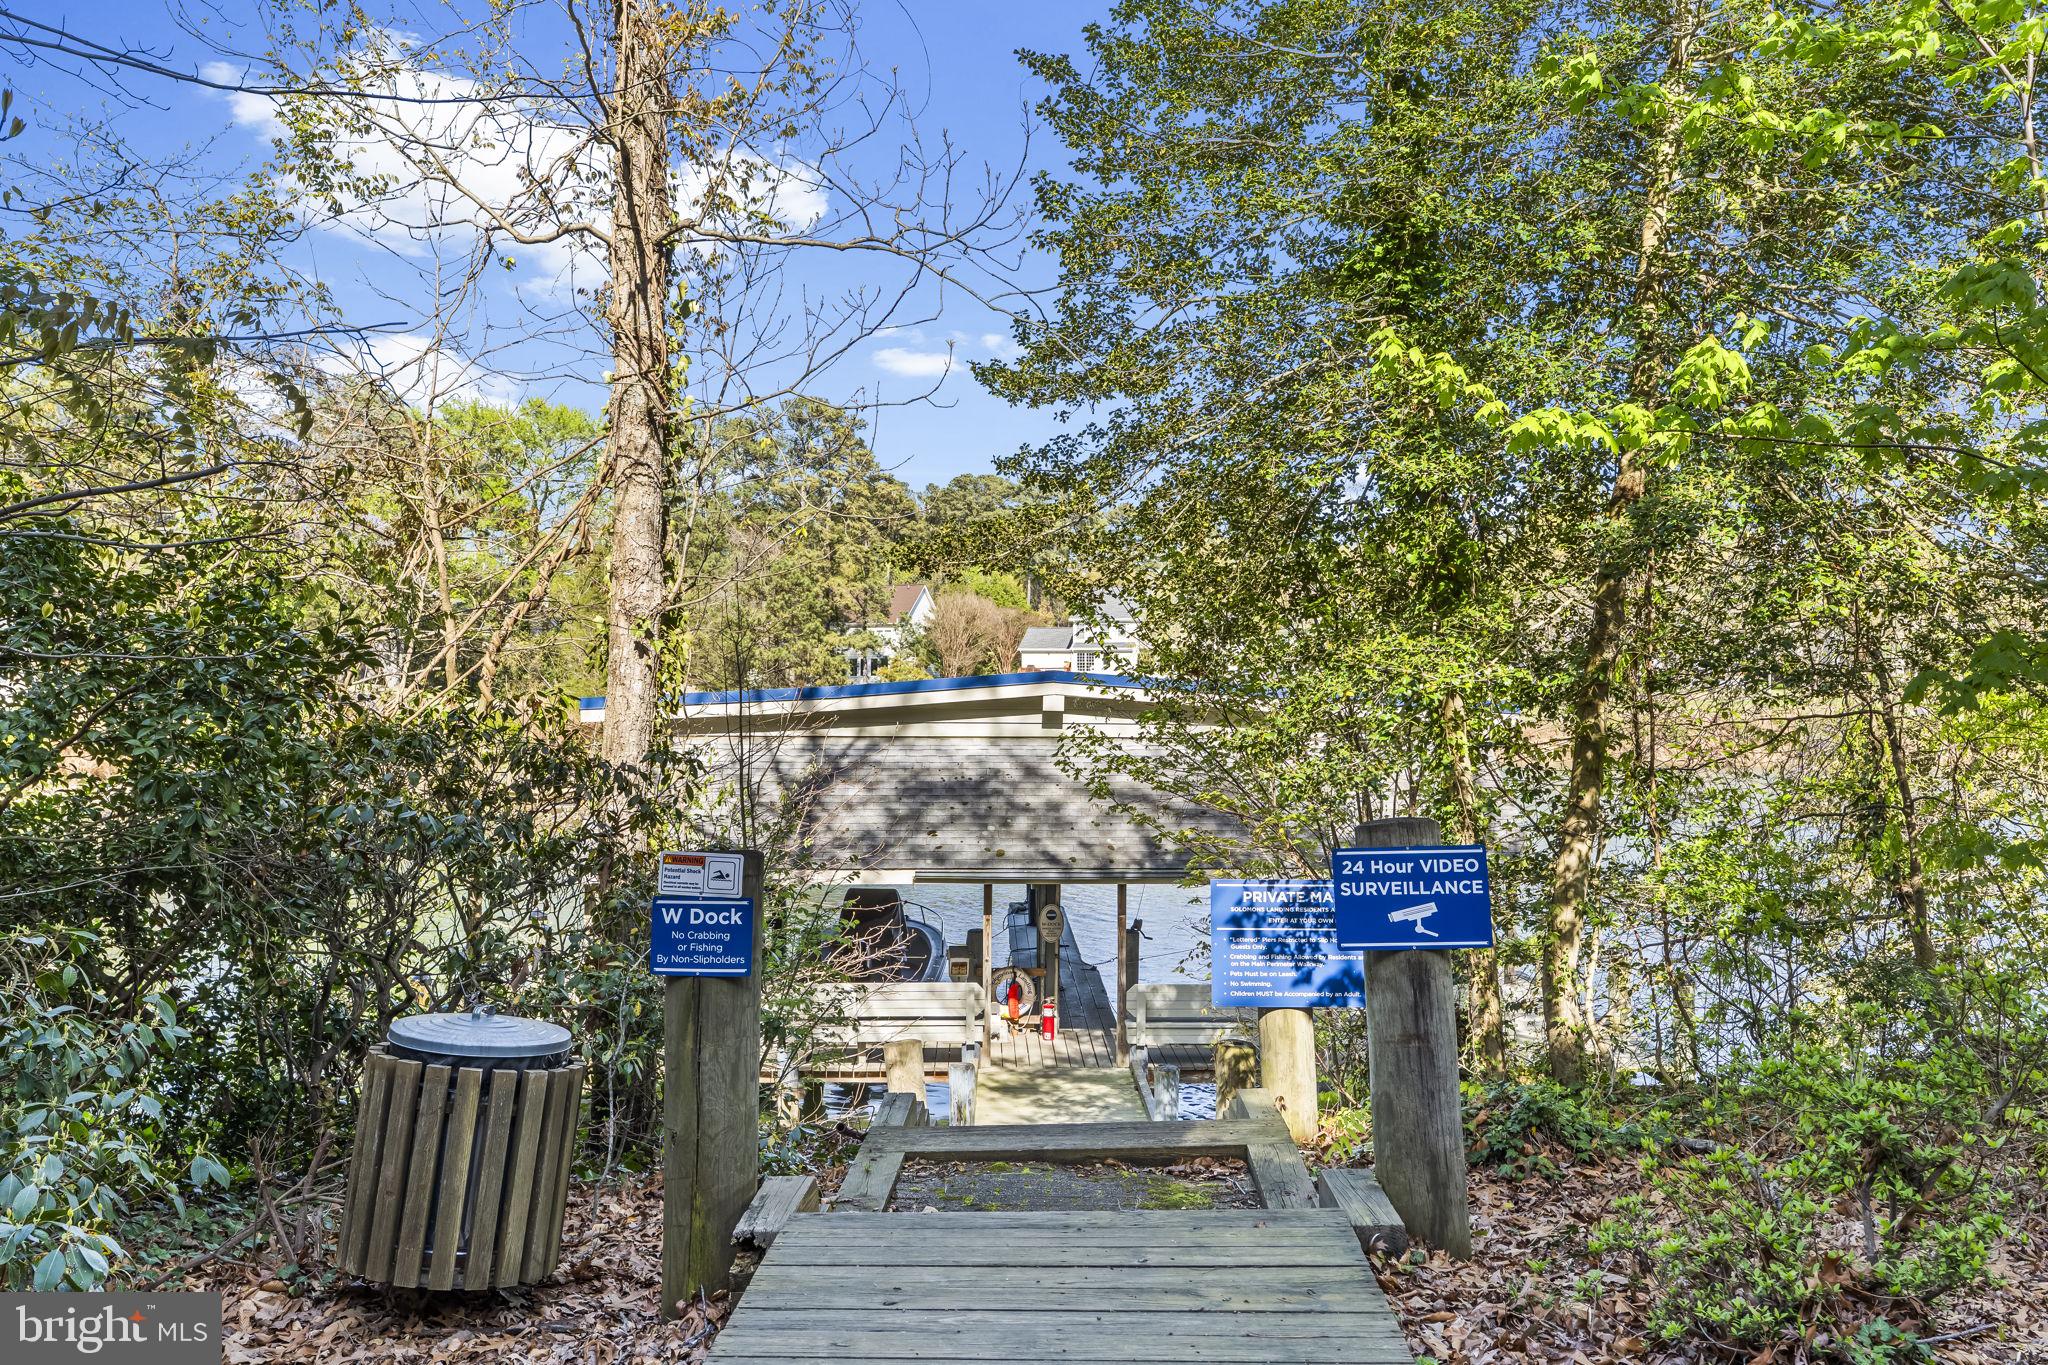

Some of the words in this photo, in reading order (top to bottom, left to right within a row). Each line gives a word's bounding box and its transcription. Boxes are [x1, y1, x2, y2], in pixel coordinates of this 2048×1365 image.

[672, 855, 704, 864] WARNING
[1342, 860, 1364, 875] 24
[1370, 860, 1414, 874] Hour
[1419, 858, 1480, 873] VIDEO
[1340, 880, 1484, 896] SURVEILLANCE
[1243, 891, 1305, 903] PRIVATE
[1310, 891, 1334, 903] MA
[661, 908, 683, 924] W
[690, 908, 743, 925] Dock
[671, 931, 685, 939] No
[687, 931, 730, 941] Crabbing
[690, 943, 723, 953] Fishing
[656, 955, 668, 964] By
[671, 955, 745, 965] Non-Slipholders
[1229, 953, 1257, 961] Crabbing
